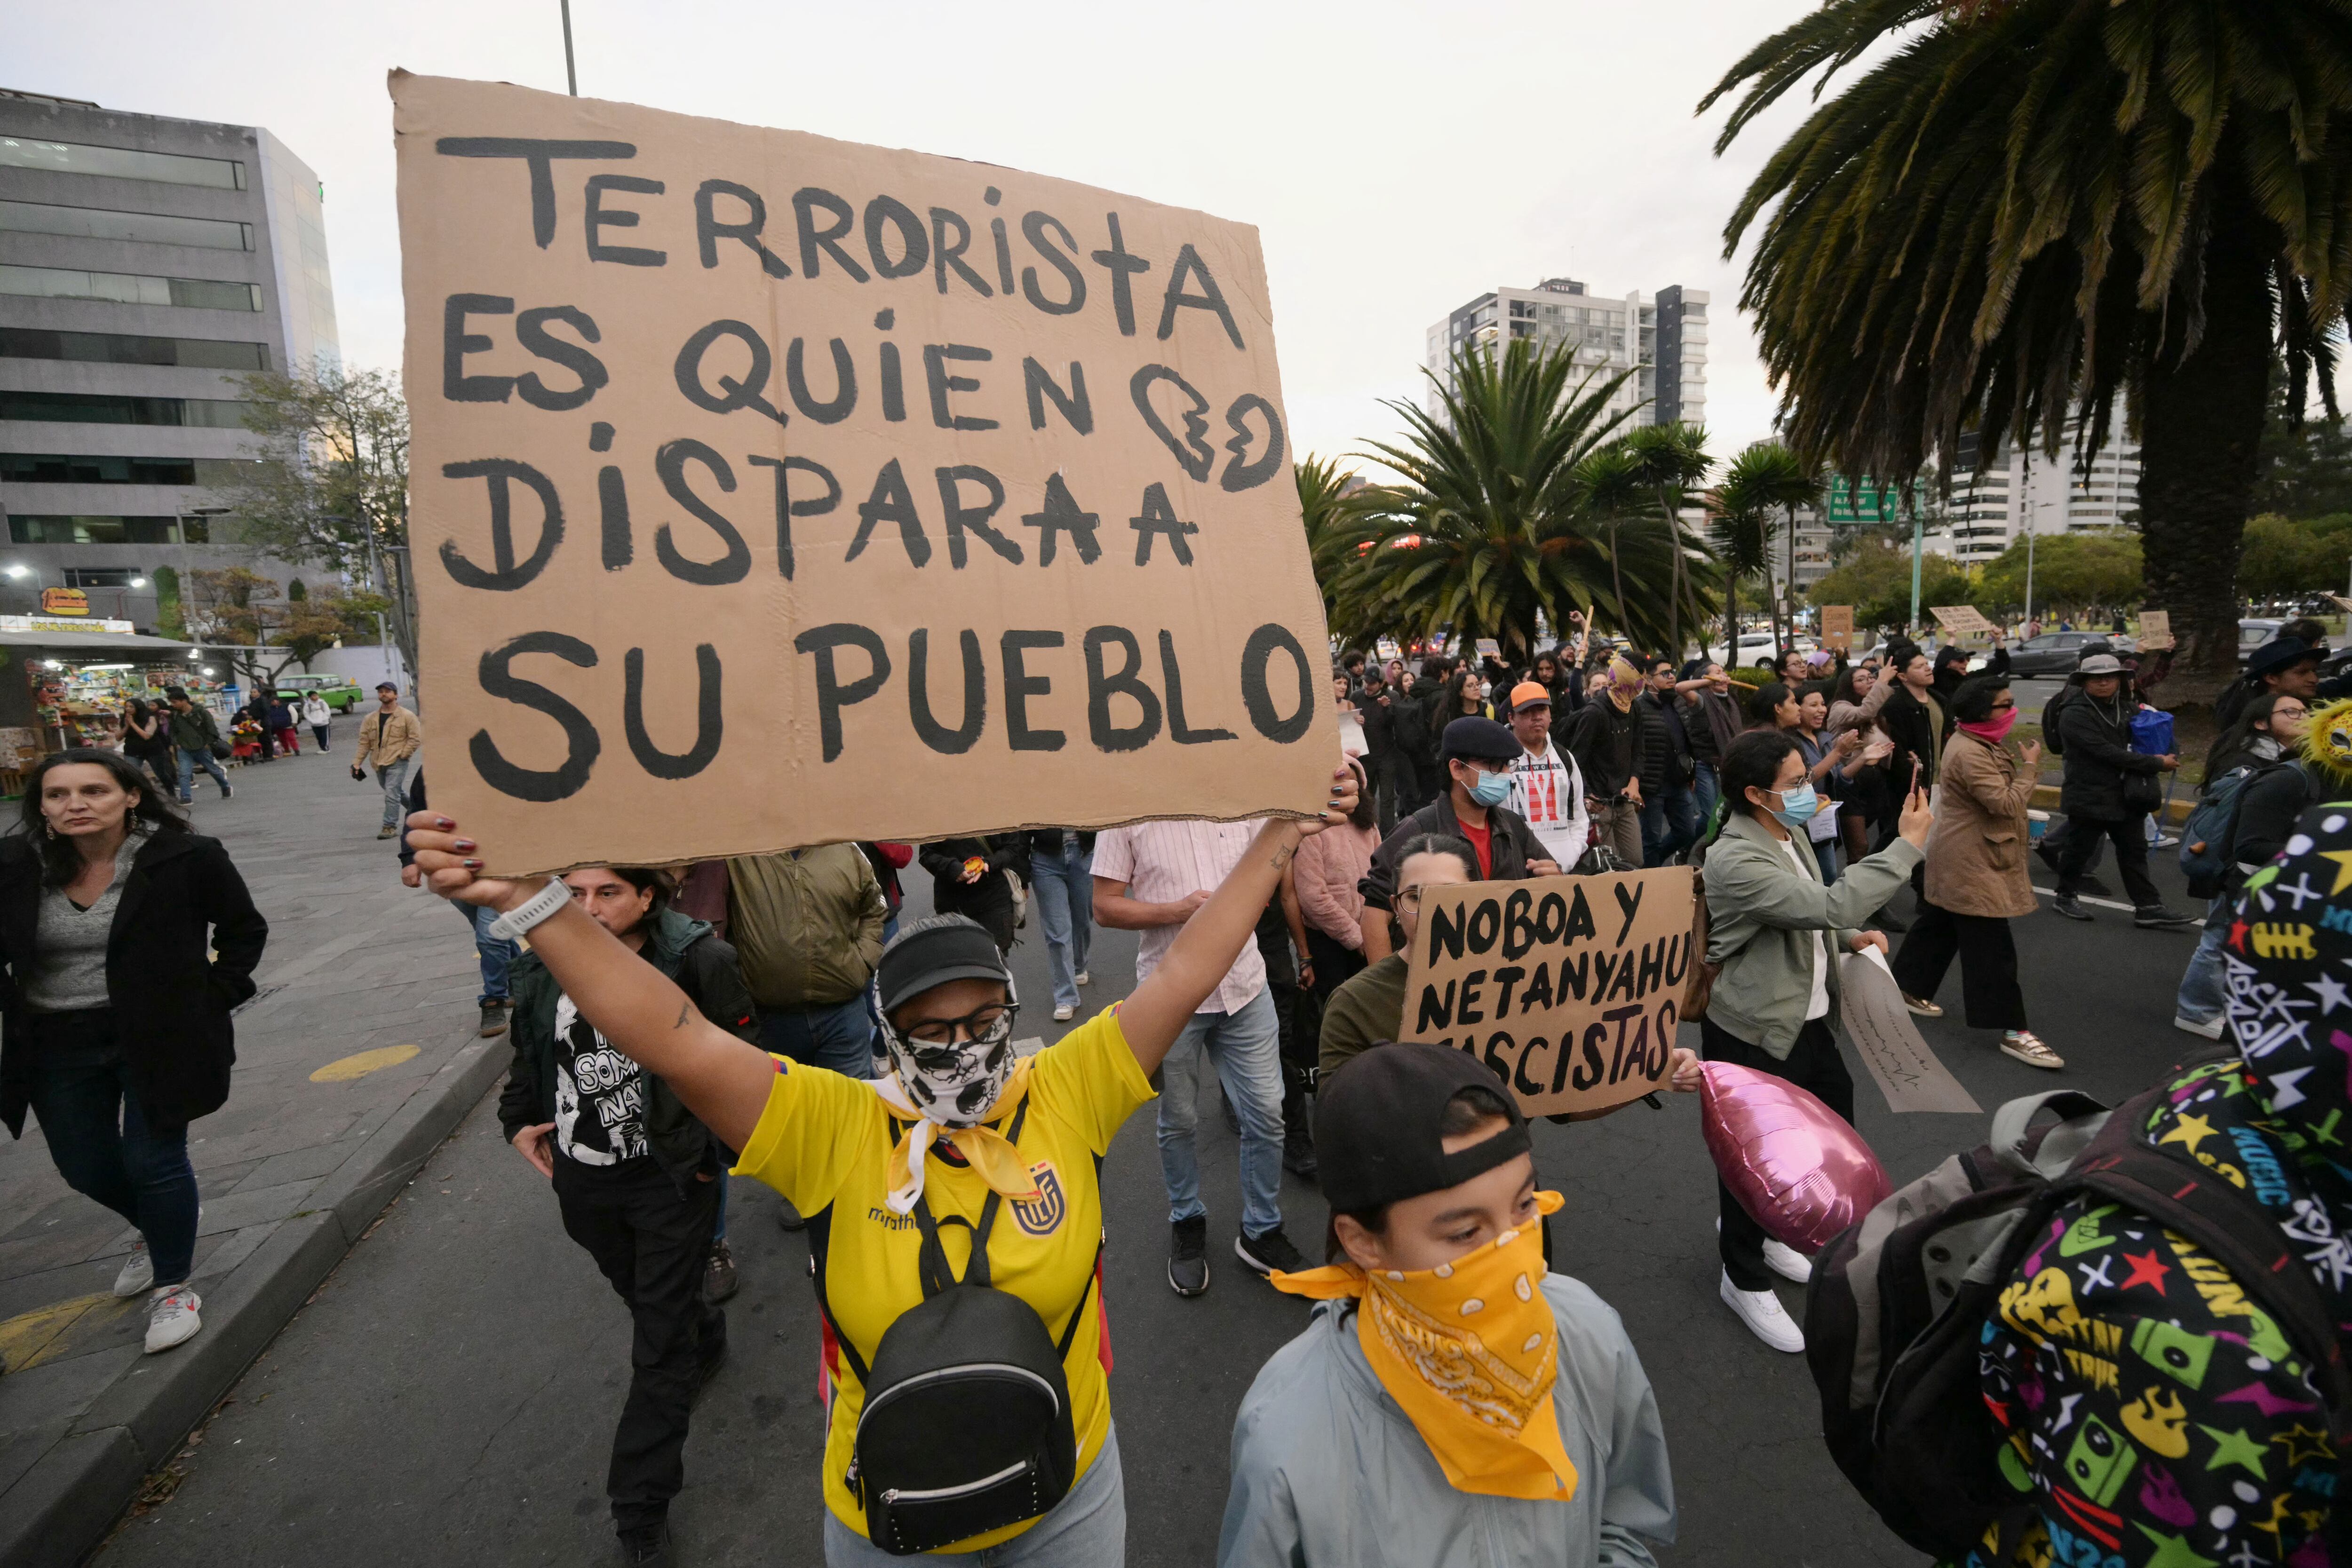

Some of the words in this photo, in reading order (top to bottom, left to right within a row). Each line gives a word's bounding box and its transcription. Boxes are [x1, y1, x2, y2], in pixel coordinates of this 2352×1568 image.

[444, 293, 609, 411] ES
[1129, 483, 1199, 567] A
[469, 631, 723, 802] SU
[793, 623, 1314, 763] PUEBLO
[1429, 884, 1596, 969] NOBOA
[1614, 881, 1644, 948] Y
[1416, 931, 1691, 1034] NETANYAHU
